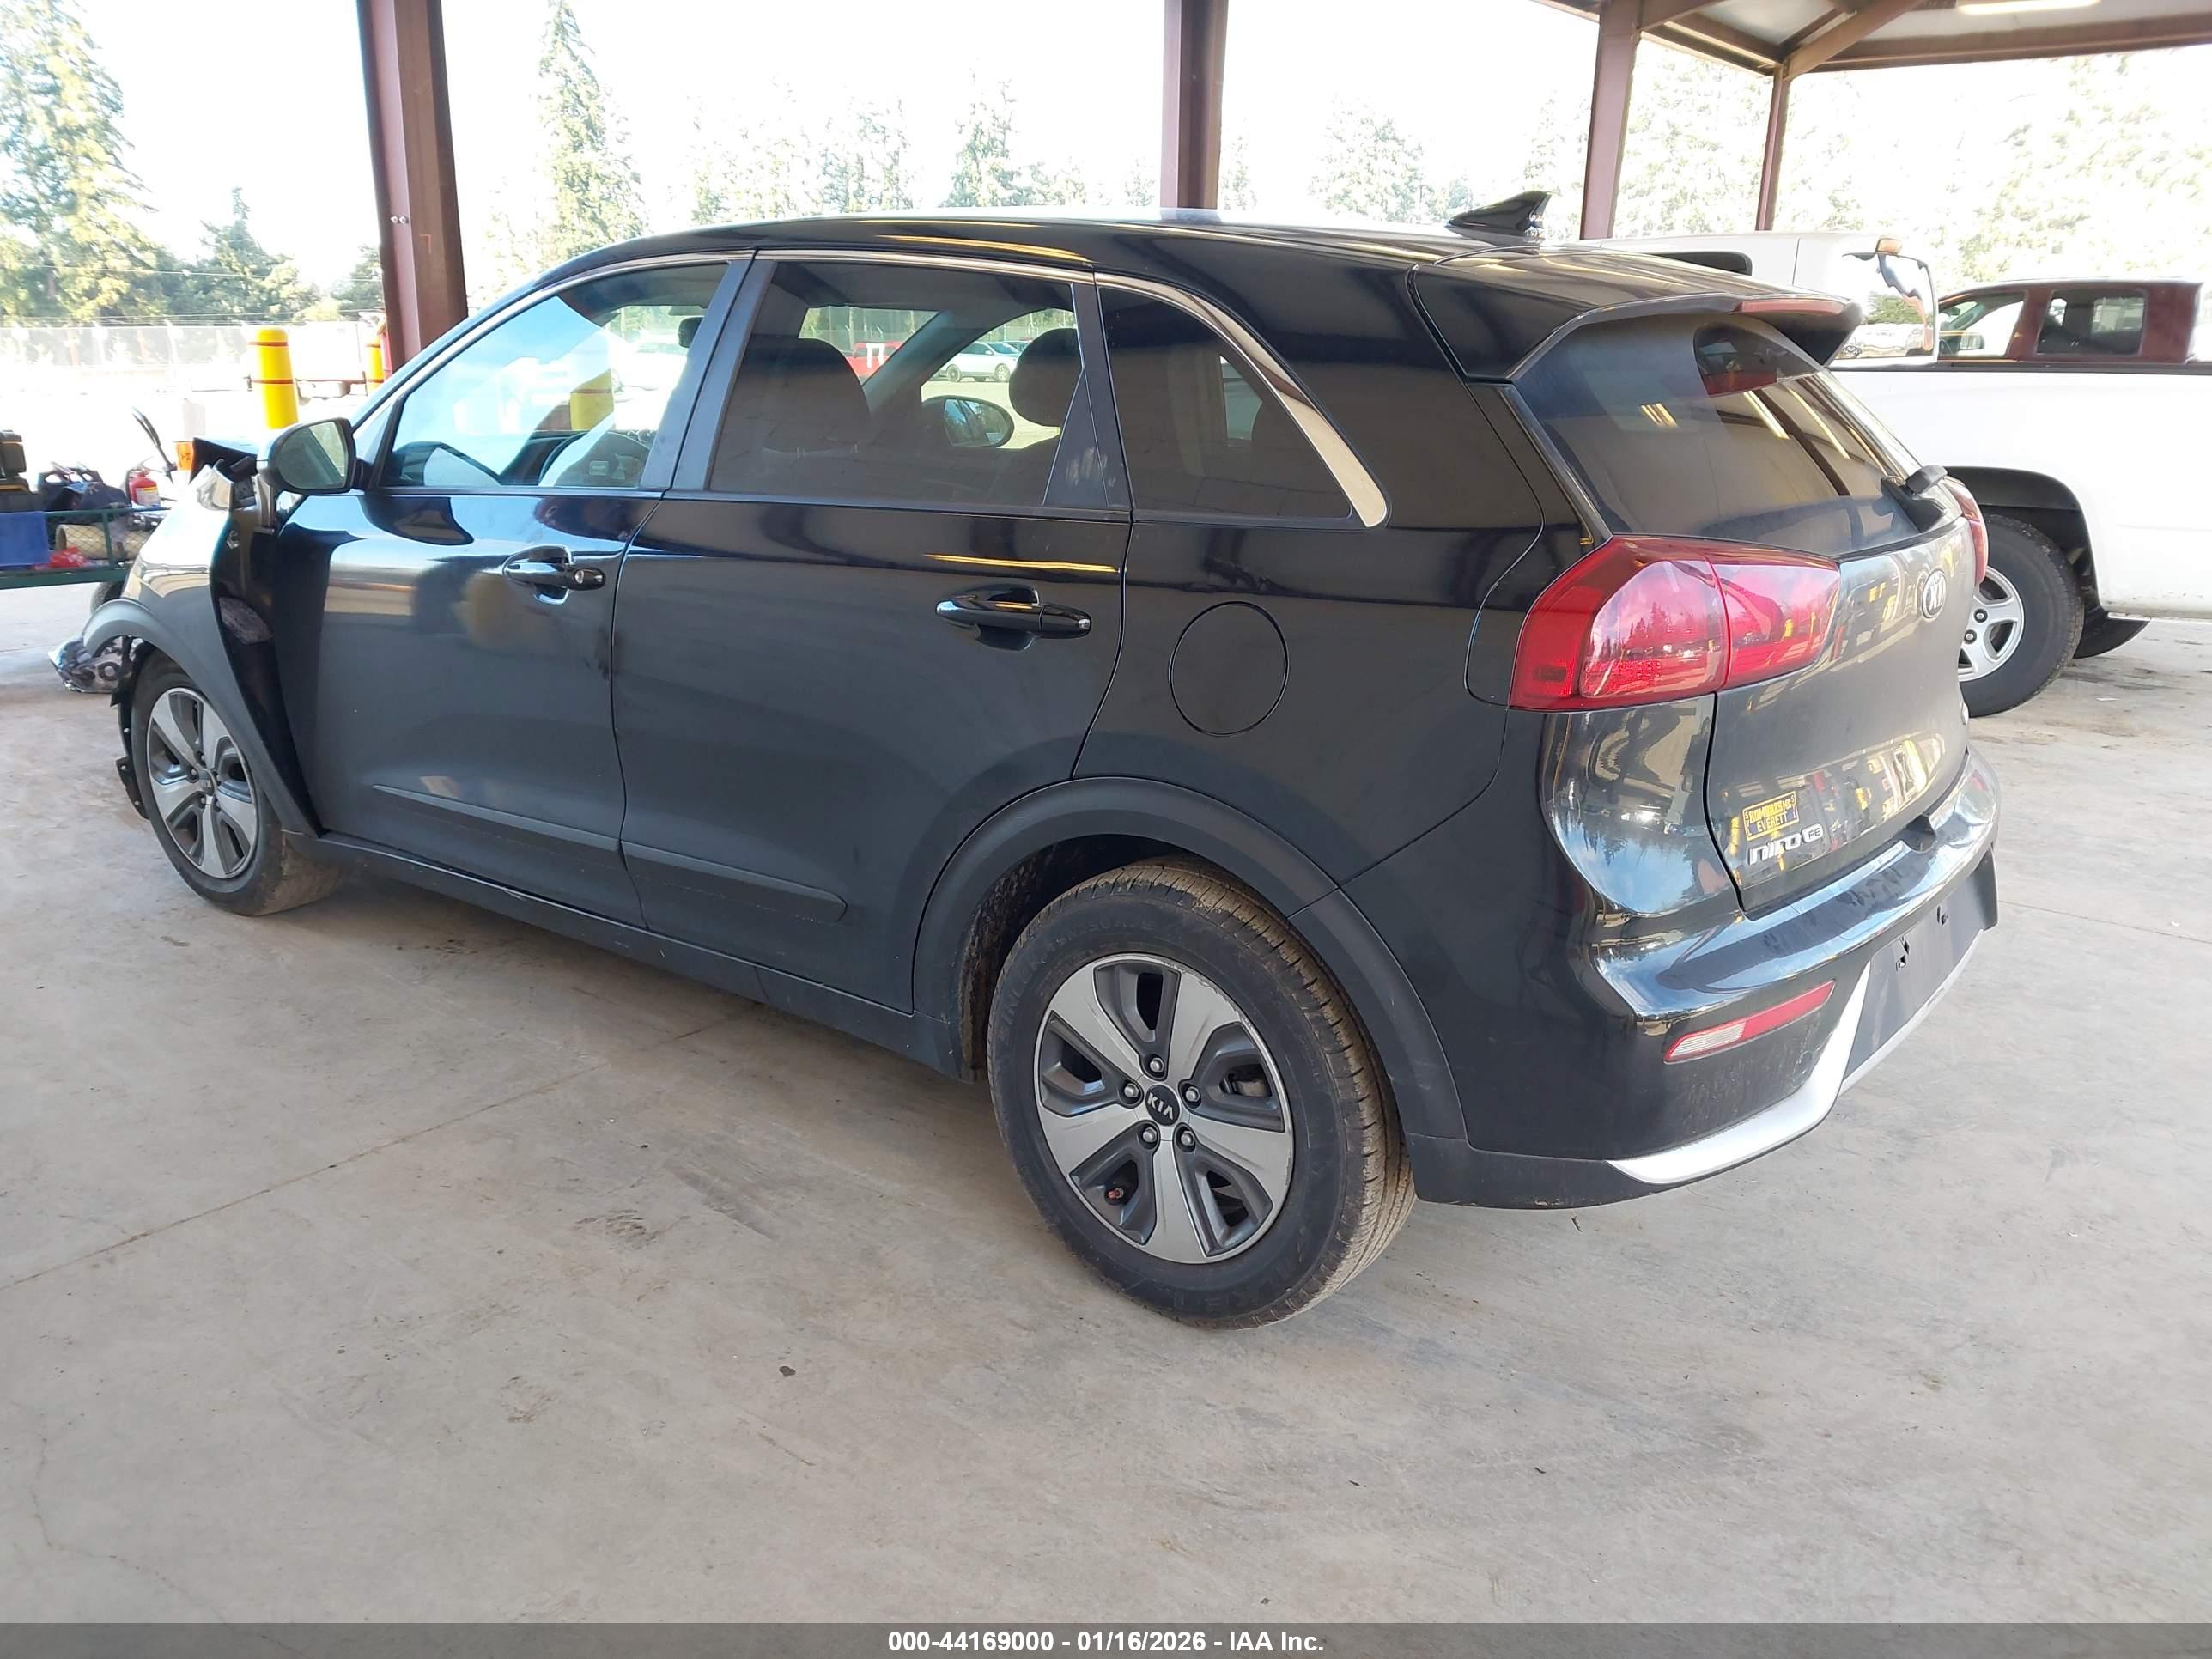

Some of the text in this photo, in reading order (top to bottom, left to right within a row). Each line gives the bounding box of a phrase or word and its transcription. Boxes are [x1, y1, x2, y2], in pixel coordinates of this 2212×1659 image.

[1756, 811, 1787, 833] EVERETT
[1808, 827, 1821, 839] FE
[1147, 1091, 1174, 1121] KIA
